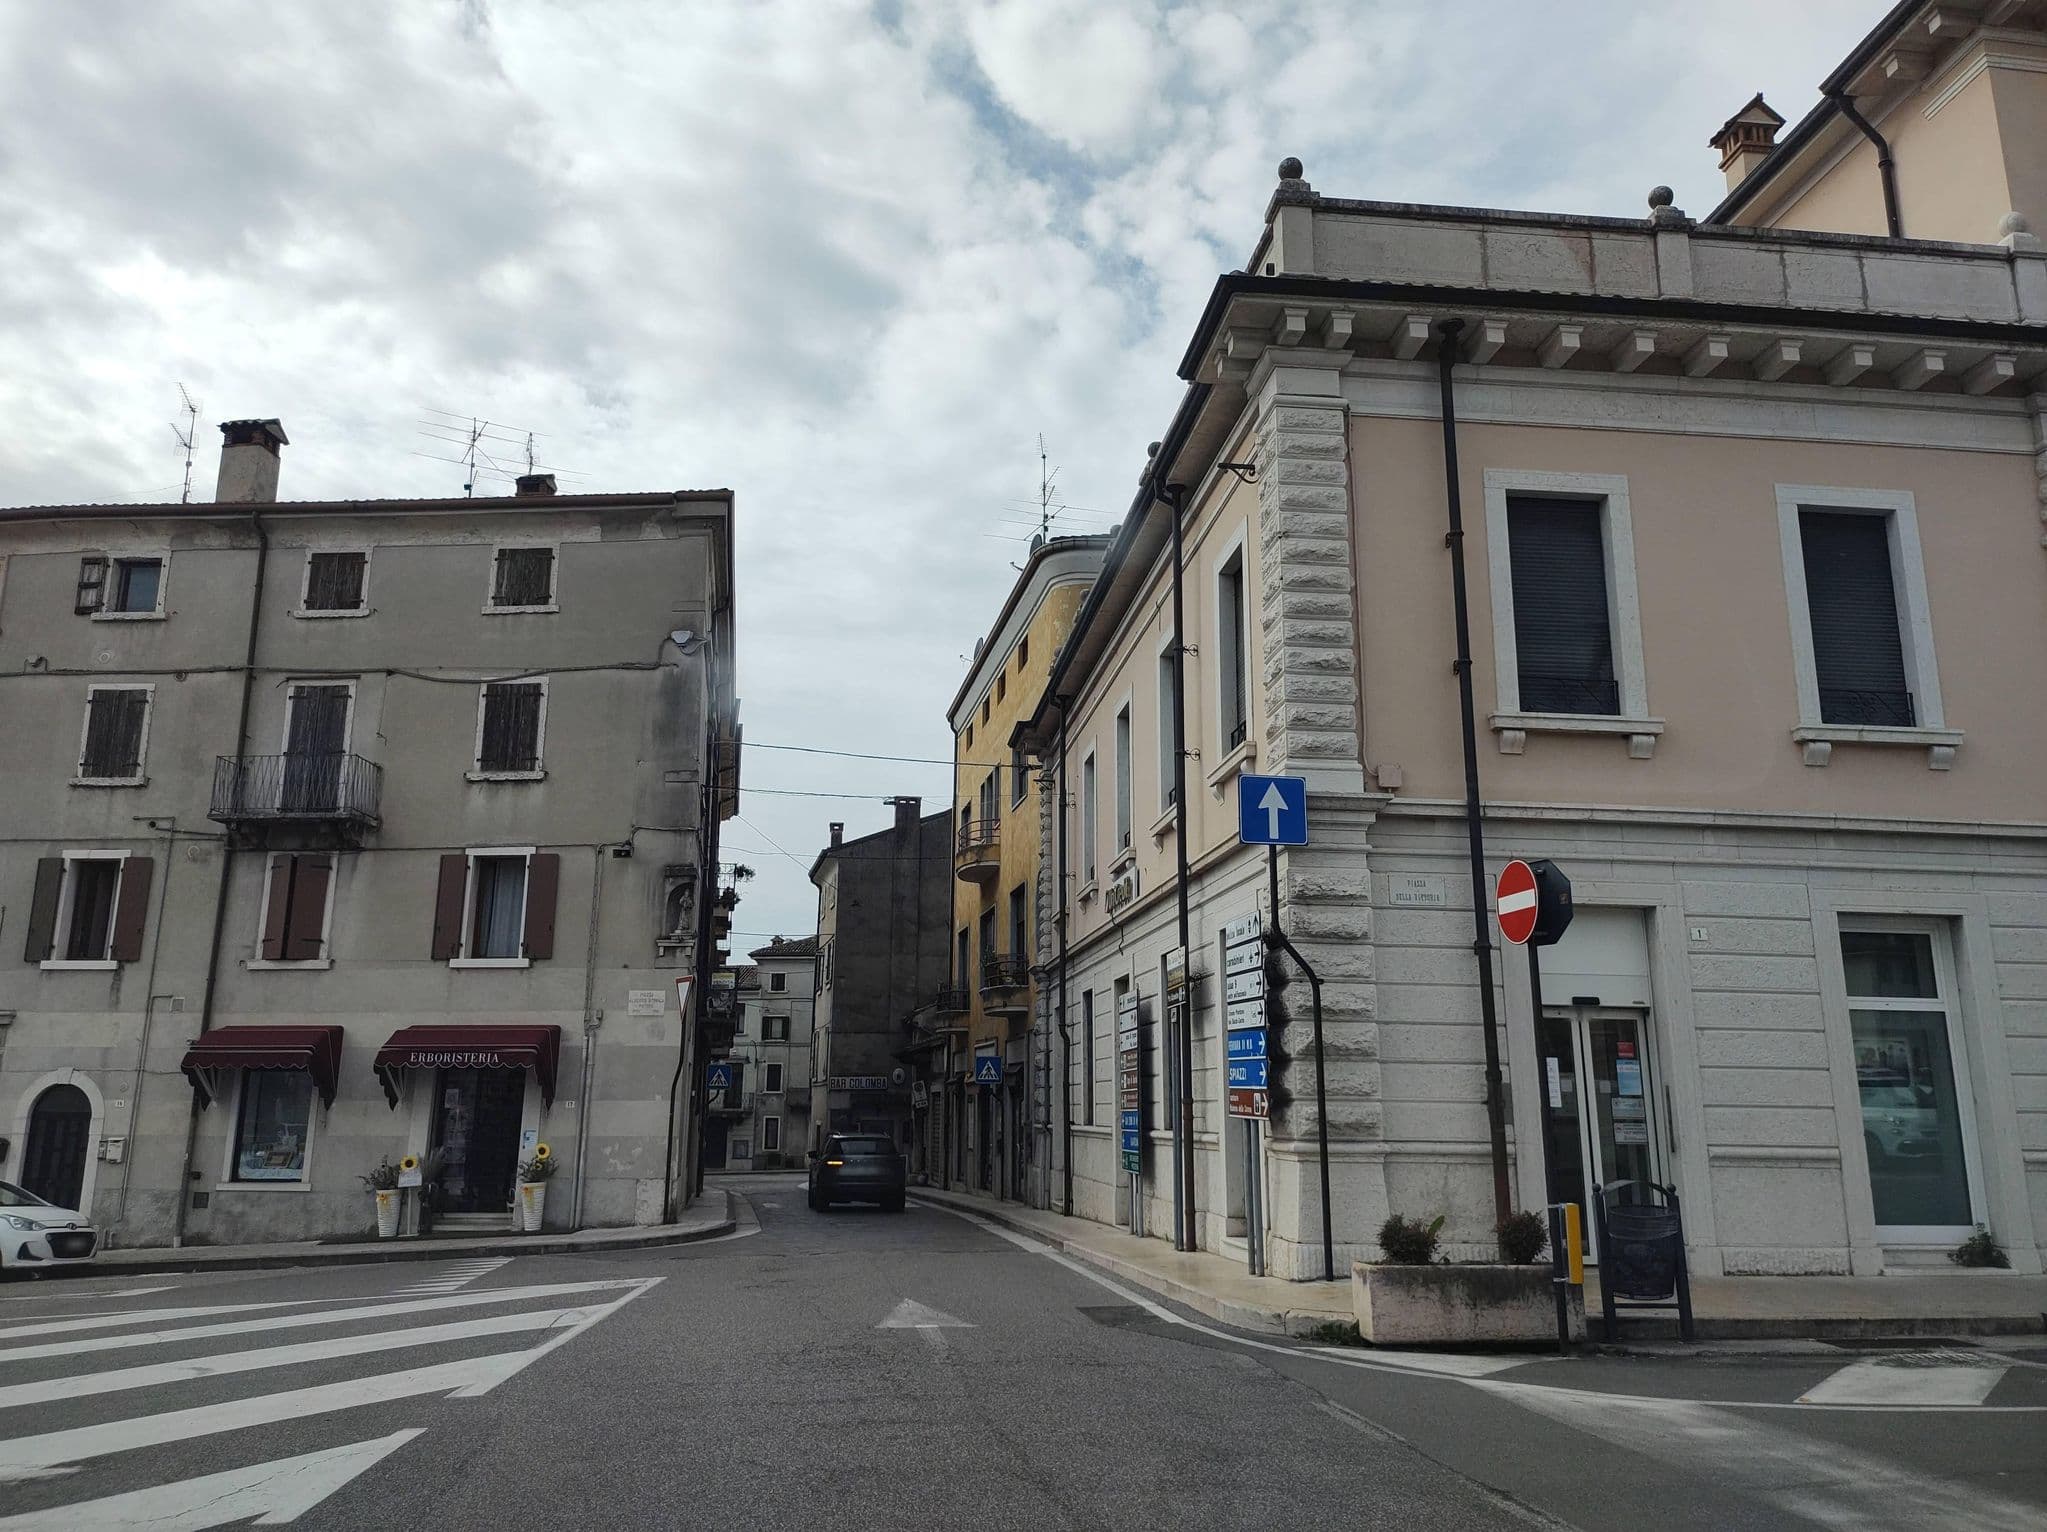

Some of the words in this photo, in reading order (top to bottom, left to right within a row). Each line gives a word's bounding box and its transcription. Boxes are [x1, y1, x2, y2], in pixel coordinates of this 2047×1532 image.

[410, 1052, 499, 1063] ERBORISTERIA
[1229, 1068, 1246, 1080] SPIAZZI
[830, 1078, 847, 1089] BAR
[849, 1077, 887, 1089] COLOMBA
